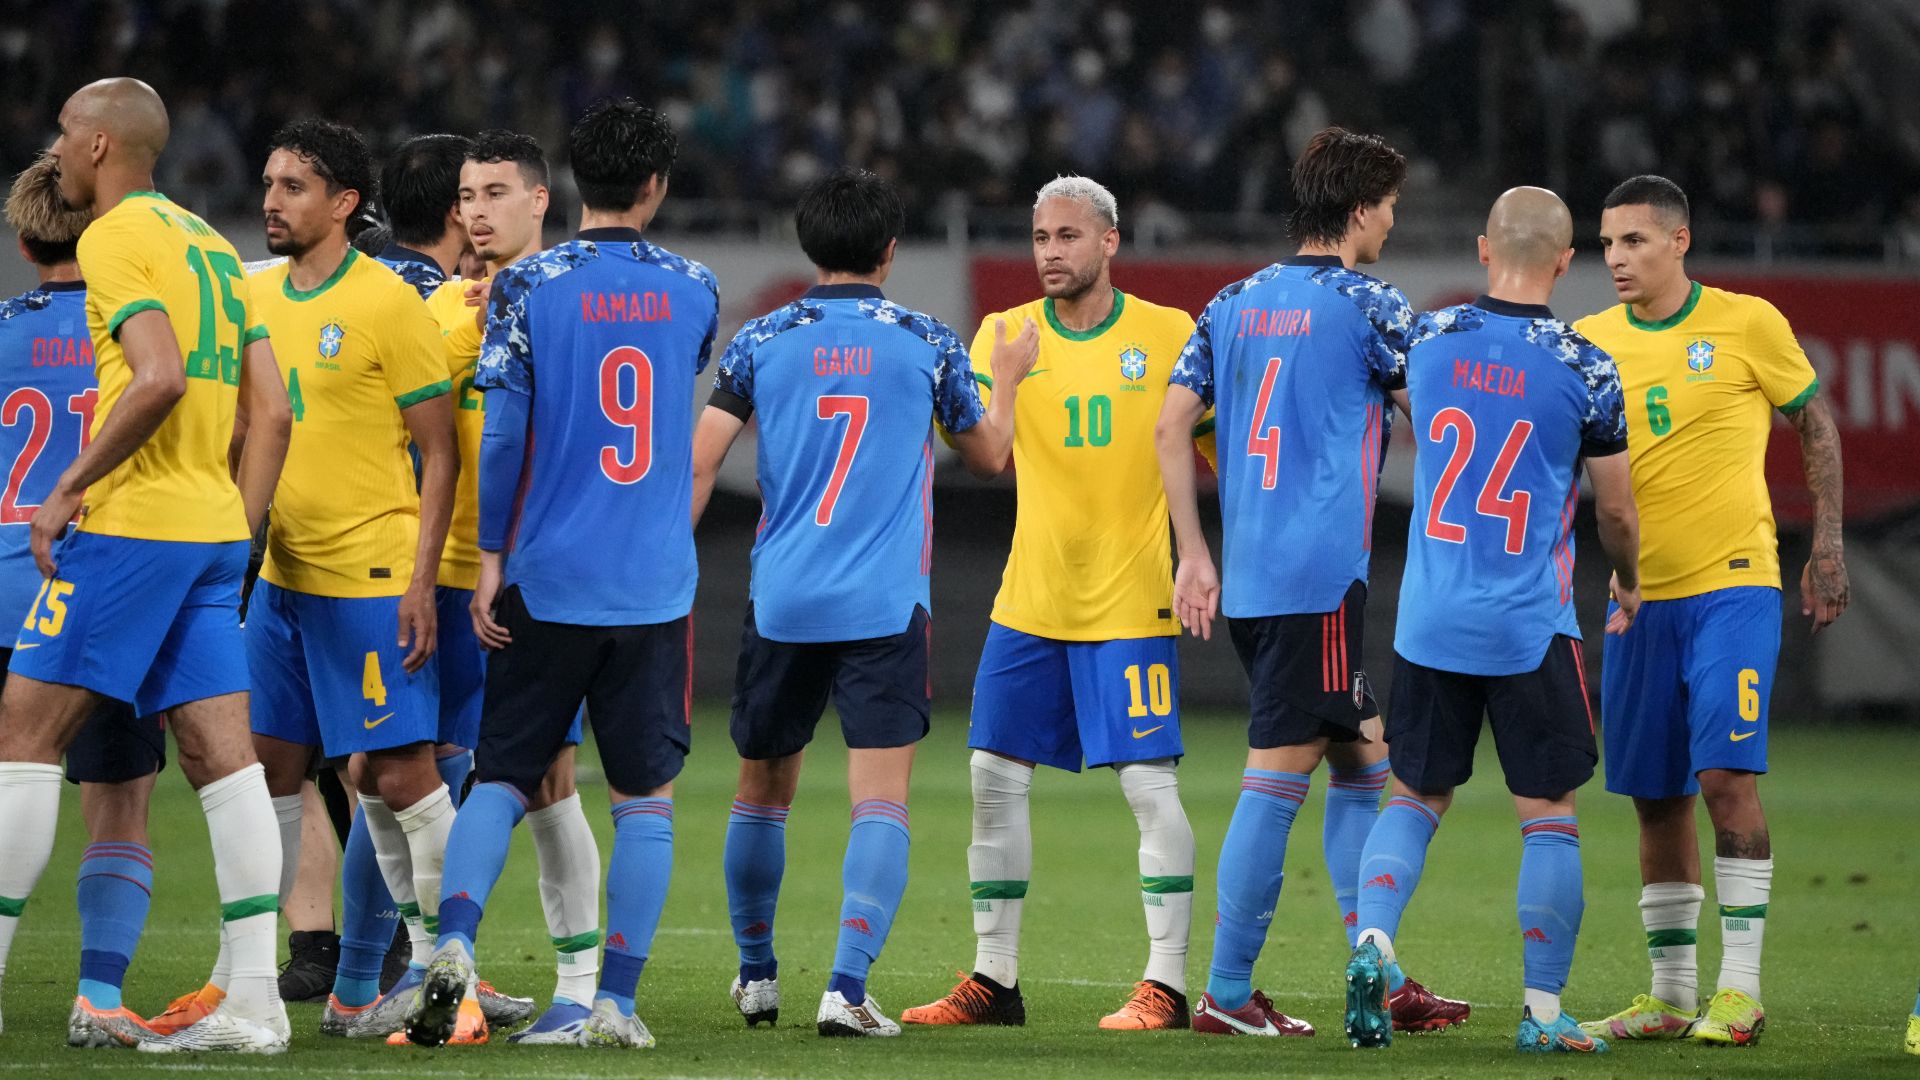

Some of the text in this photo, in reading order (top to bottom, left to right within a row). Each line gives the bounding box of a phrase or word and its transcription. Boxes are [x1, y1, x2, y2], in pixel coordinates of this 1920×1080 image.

[186, 244, 246, 387] 15
[581, 292, 672, 322] KAMADA
[1237, 308, 1311, 337] ITAKURA
[32, 337, 94, 367] DOAN
[814, 346, 873, 376] GAKU
[1452, 358, 1526, 400] MAEDA
[287, 368, 305, 422] 4
[600, 346, 653, 484] 9
[1064, 395, 1112, 448] 10
[1646, 385, 1670, 436] 6
[1247, 357, 1282, 490] 4
[1, 386, 99, 525] 21
[817, 395, 869, 526] 7
[1425, 407, 1533, 555] 24
[23, 577, 75, 637] 15
[362, 651, 387, 706] 4
[1124, 664, 1171, 718] 10
[1738, 668, 1759, 722] 6
[1725, 918, 1751, 931] BRASIL
